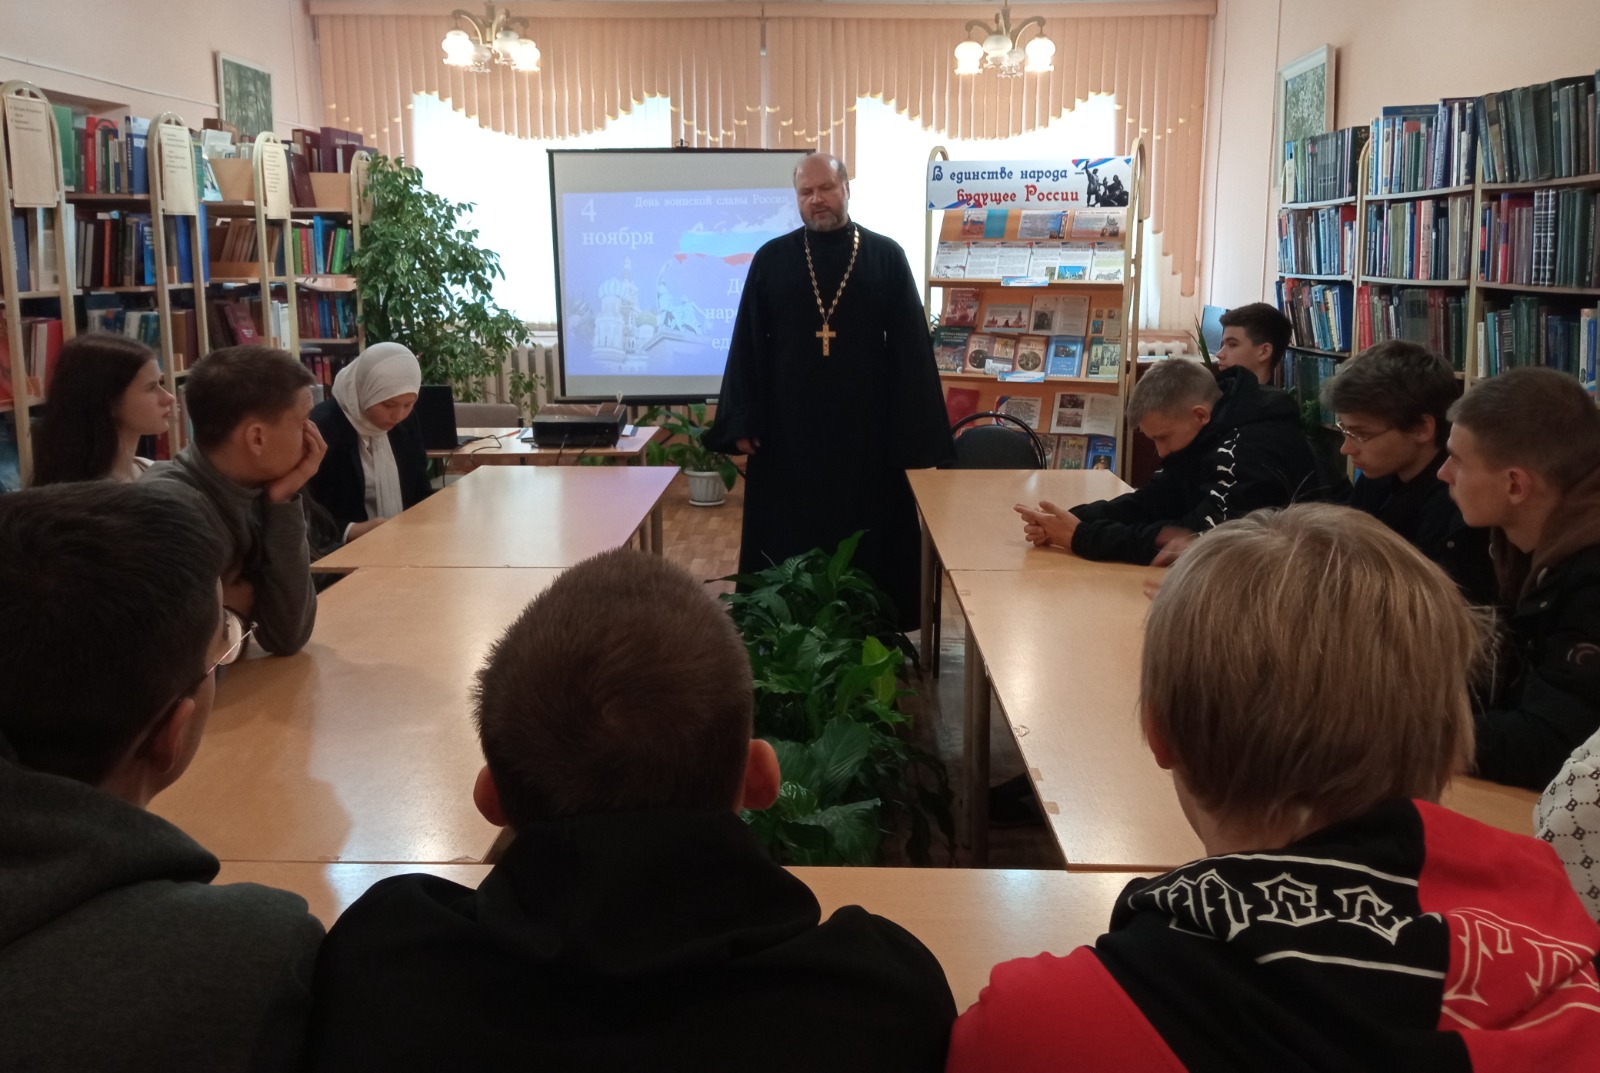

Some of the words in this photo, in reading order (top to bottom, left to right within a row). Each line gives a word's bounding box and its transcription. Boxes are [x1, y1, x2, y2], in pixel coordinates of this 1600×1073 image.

[931, 165, 944, 181] В
[949, 166, 1014, 184] единстве
[1020, 169, 1068, 182] народа
[634, 196, 661, 208] День
[956, 188, 1017, 206] будущее
[1024, 184, 1080, 202] России
[580, 198, 597, 223] 4
[581, 226, 656, 250] ноября
[704, 308, 739, 324] нар
